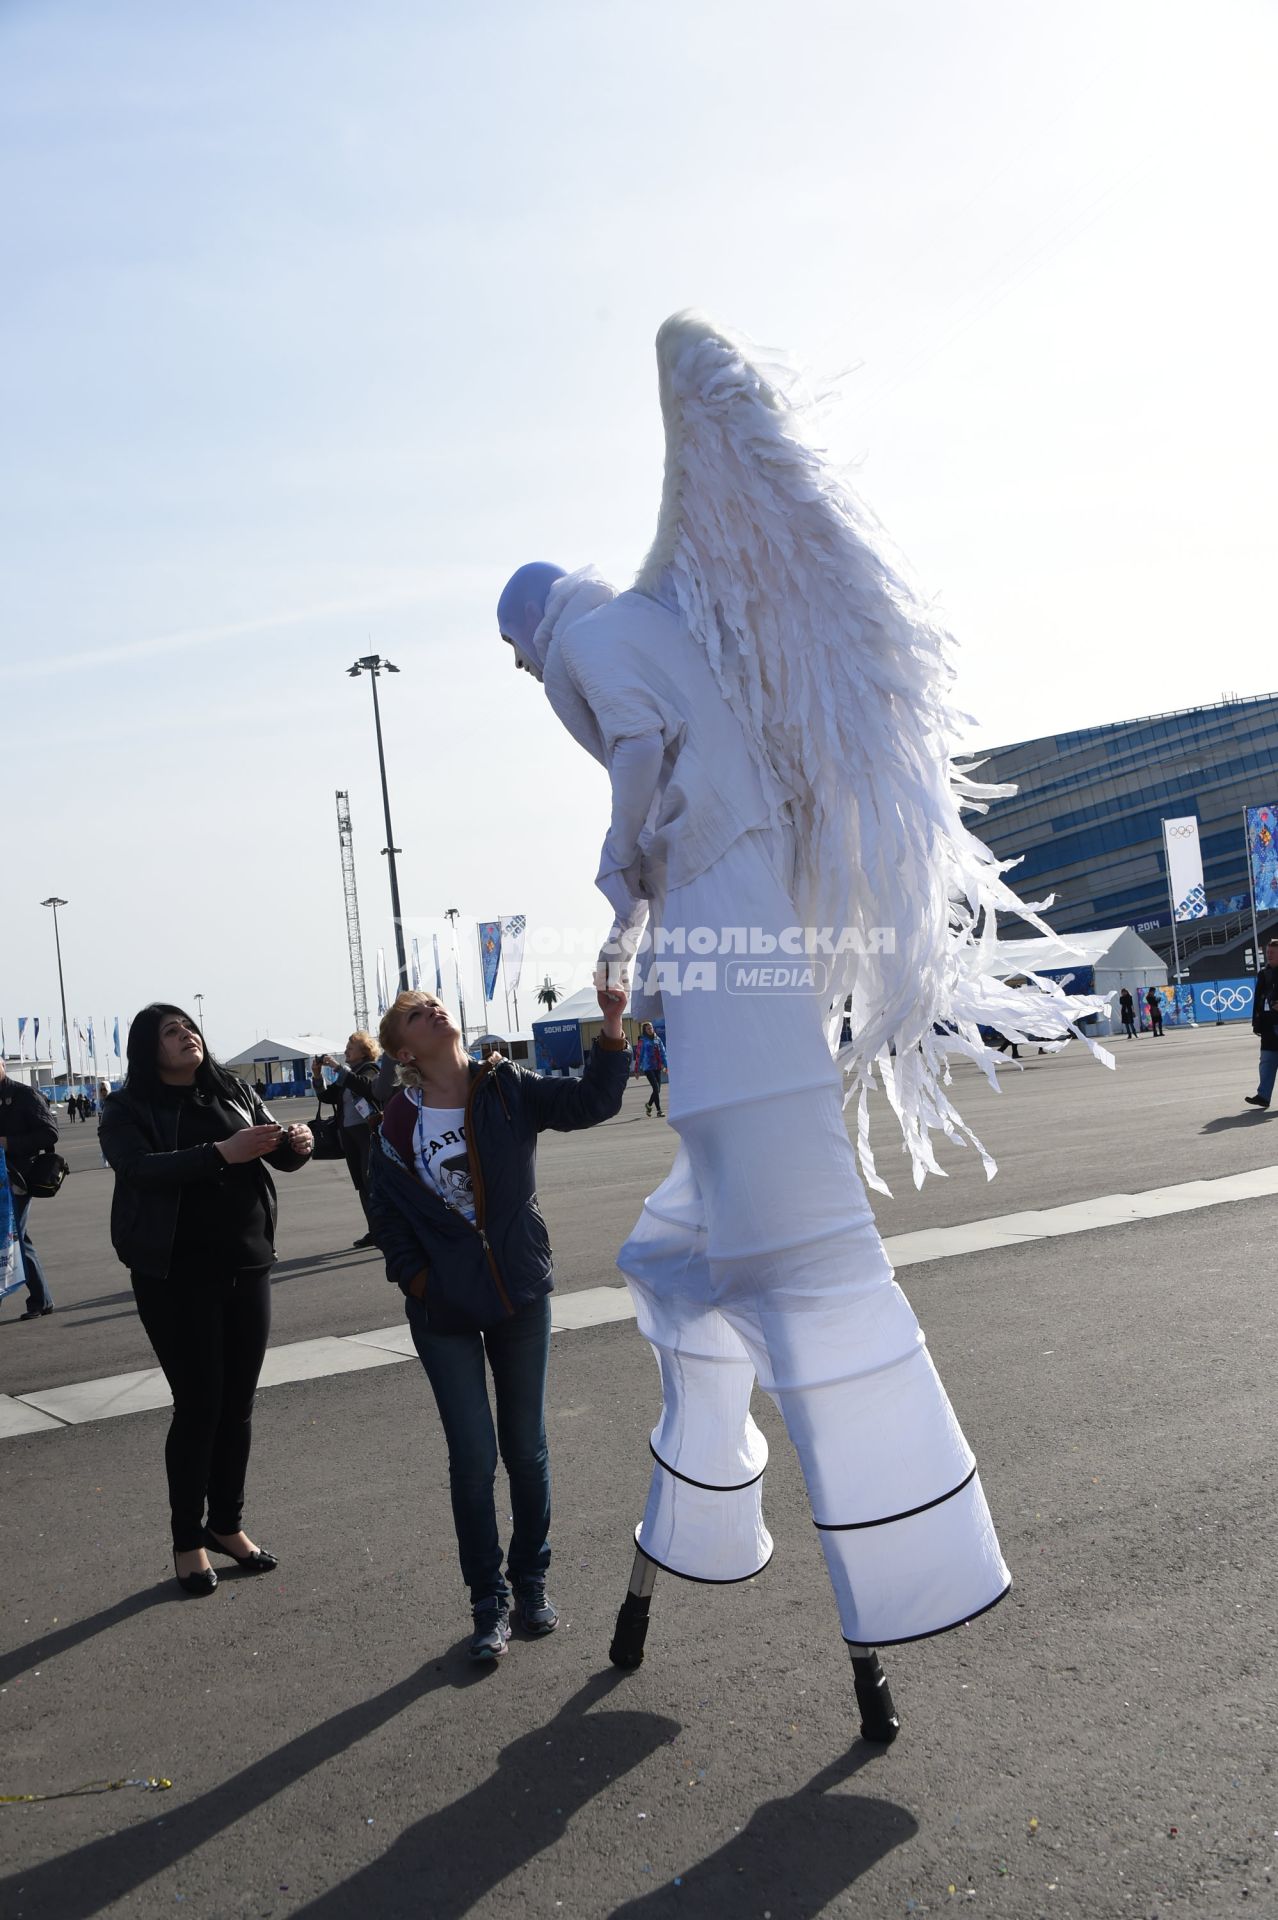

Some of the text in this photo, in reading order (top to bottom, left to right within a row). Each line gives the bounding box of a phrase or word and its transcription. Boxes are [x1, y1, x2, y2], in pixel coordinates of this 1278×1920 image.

[1138, 920, 1159, 932] 2014
[544, 1024, 577, 1034] SOCHI 2014
